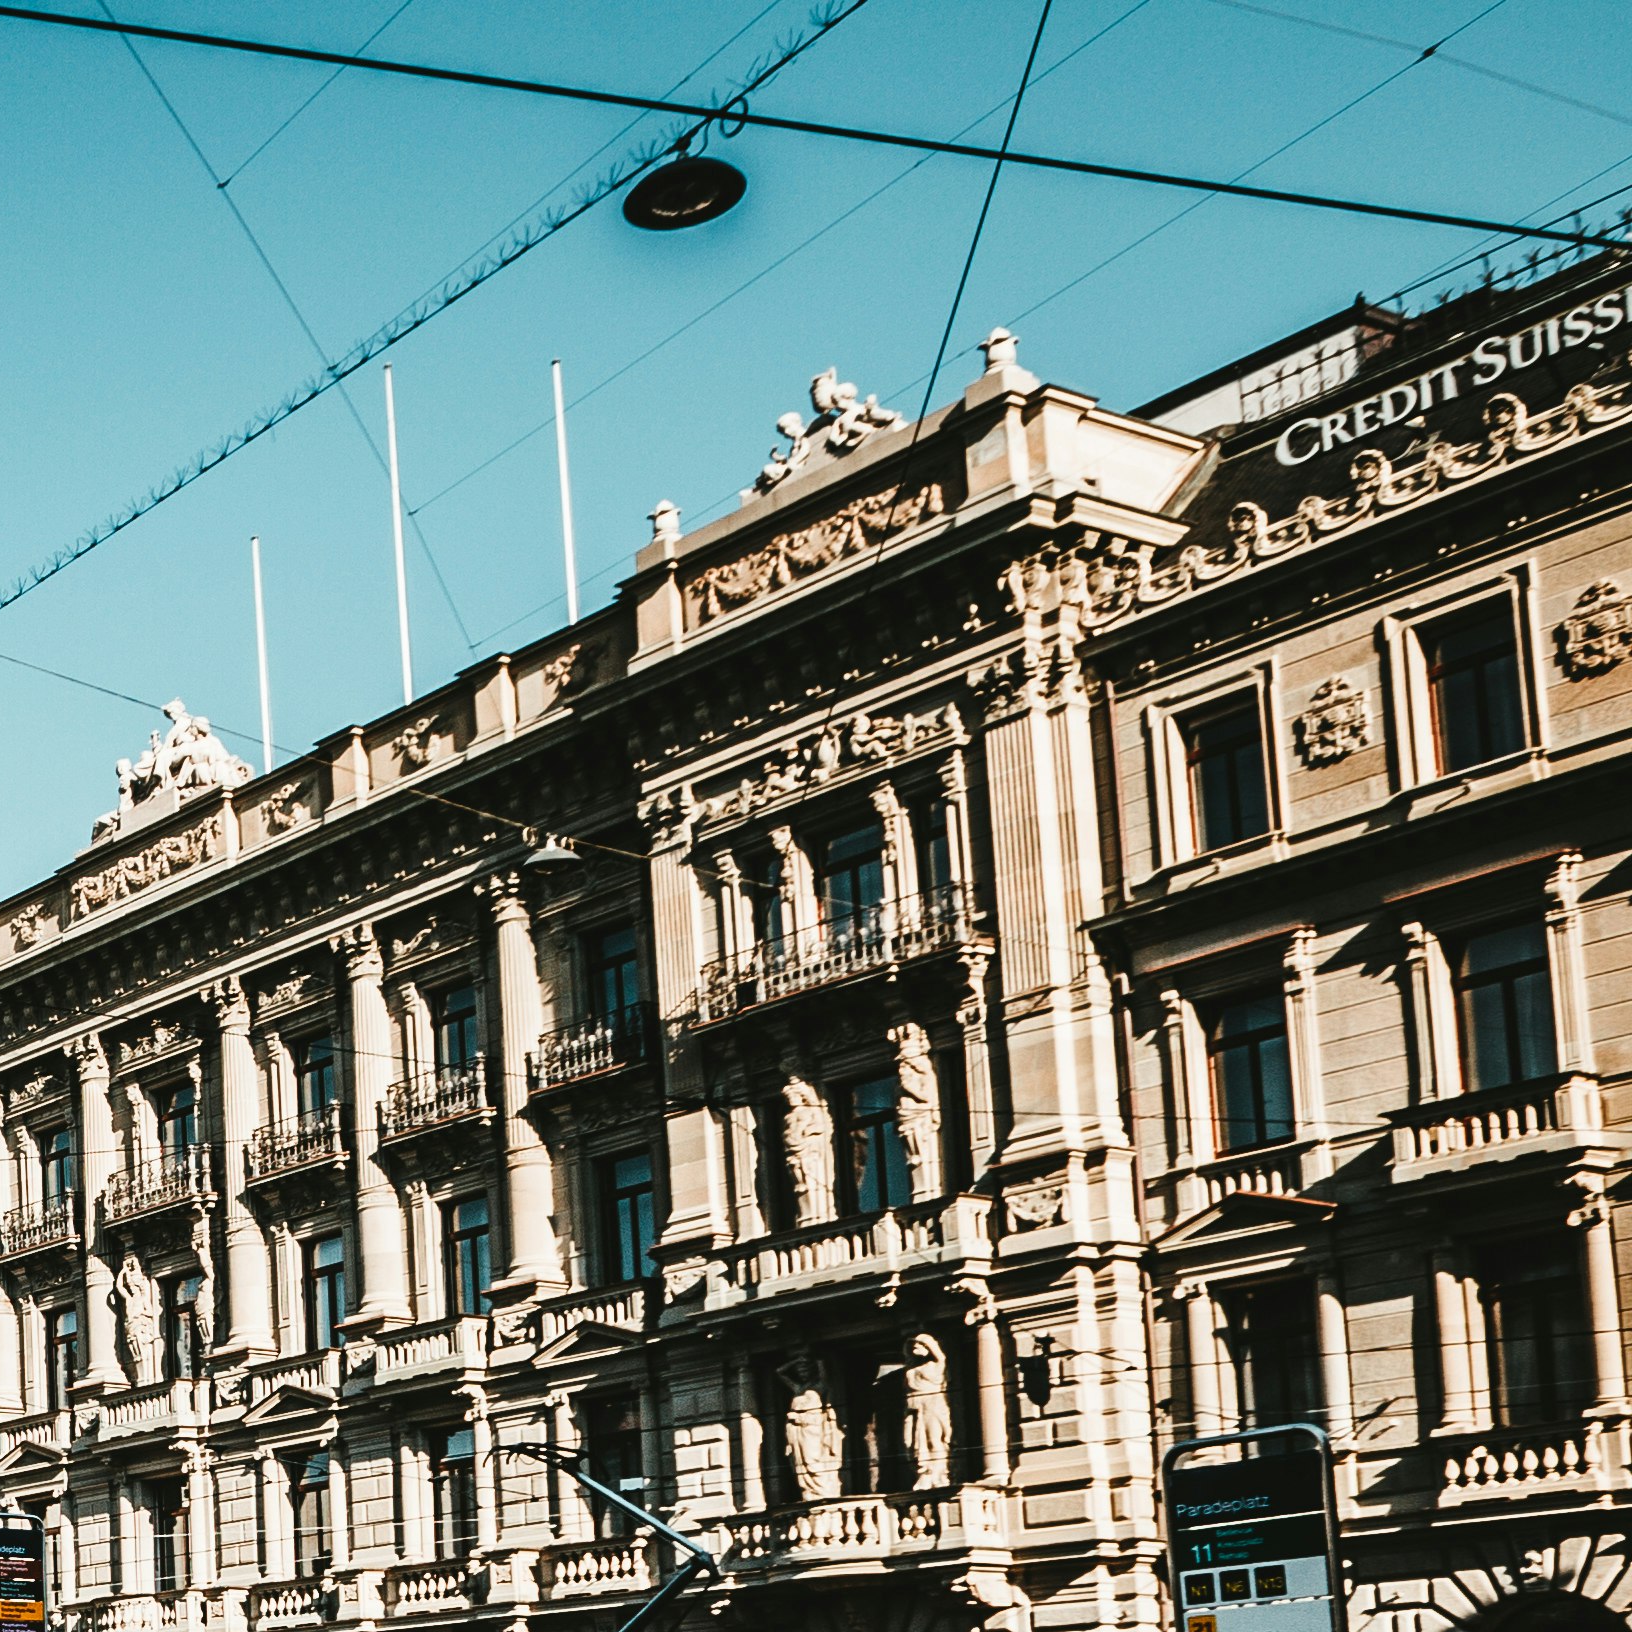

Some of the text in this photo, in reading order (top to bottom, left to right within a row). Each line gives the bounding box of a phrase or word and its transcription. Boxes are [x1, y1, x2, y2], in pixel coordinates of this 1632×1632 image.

[1275, 285, 1632, 466] CREDIT SUISS
[1176, 1495, 1272, 1518] Paradeplatz
[1190, 1543, 1213, 1564] 11
